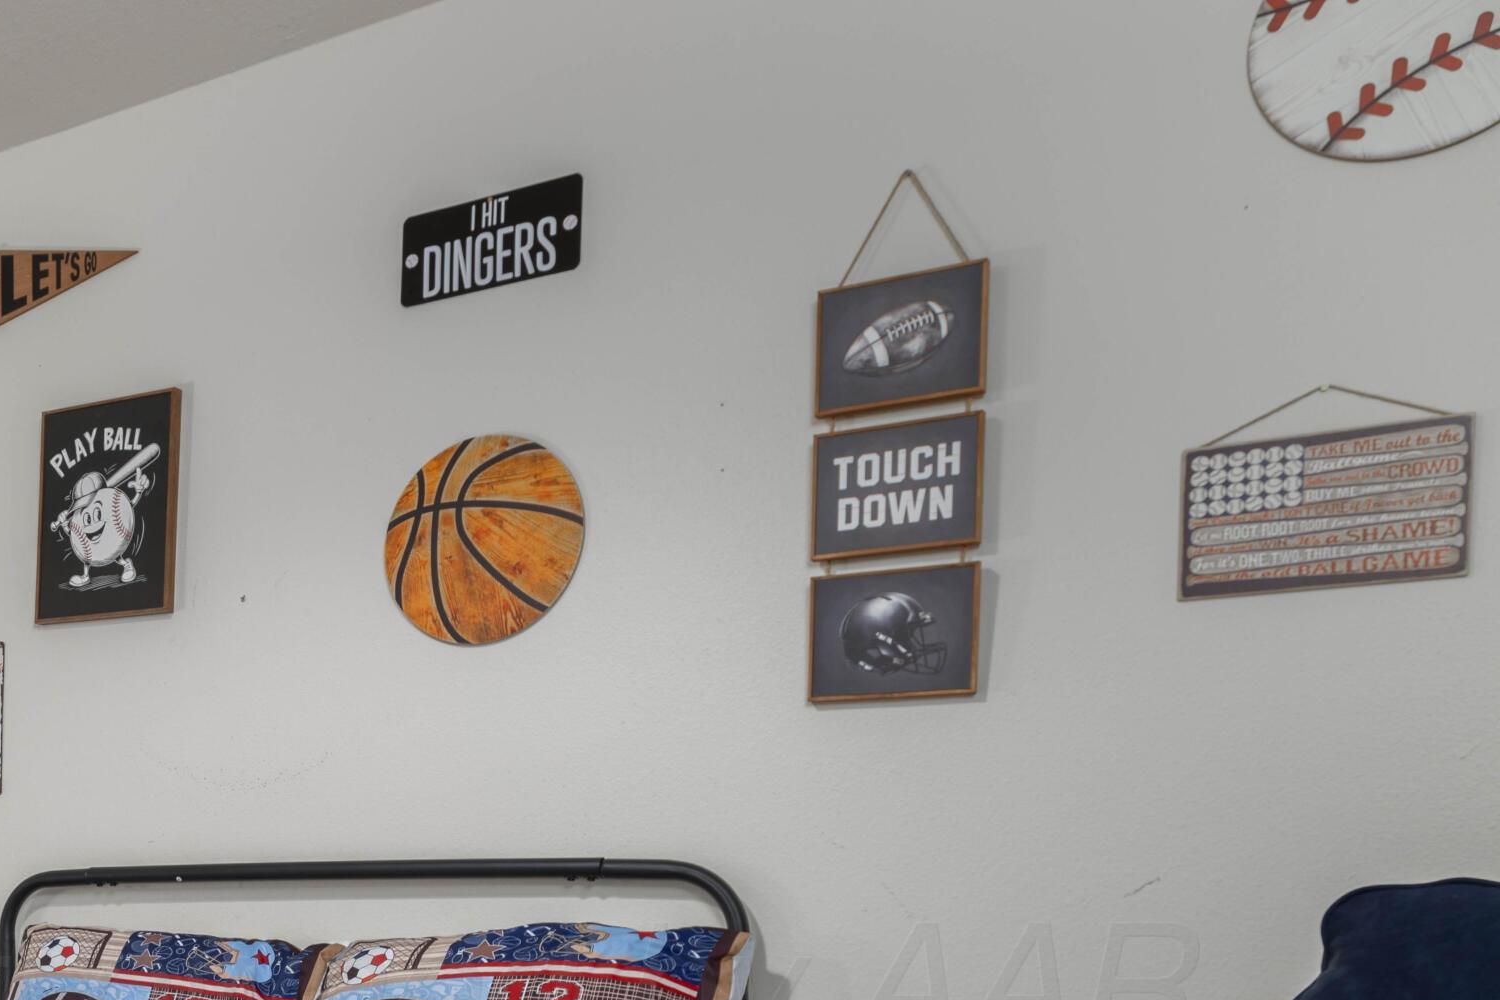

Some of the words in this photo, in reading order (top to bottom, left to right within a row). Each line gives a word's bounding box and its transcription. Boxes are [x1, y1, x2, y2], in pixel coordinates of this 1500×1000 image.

[470, 204, 476, 232] I
[481, 196, 510, 229] HIT
[422, 216, 557, 299] DINGERS
[1, 252, 80, 316] LET'S
[84, 251, 97, 275] GO
[49, 427, 98, 478] PLAY
[103, 427, 142, 451] BALL
[1310, 442, 1348, 457] TAKE
[1354, 438, 1381, 453] ME
[1386, 435, 1411, 449] out
[1416, 434, 1430, 446] to
[1437, 429, 1461, 444] the
[833, 440, 962, 491] TOUCH
[1387, 457, 1460, 479] CROWD
[837, 484, 954, 532] DOWN
[1306, 487, 1332, 501] BUY
[1334, 485, 1358, 498] ME
[1346, 517, 1456, 543] SHAME!
[1297, 549, 1452, 576] BALLGAME
[1304, 545, 1347, 561] THREE
